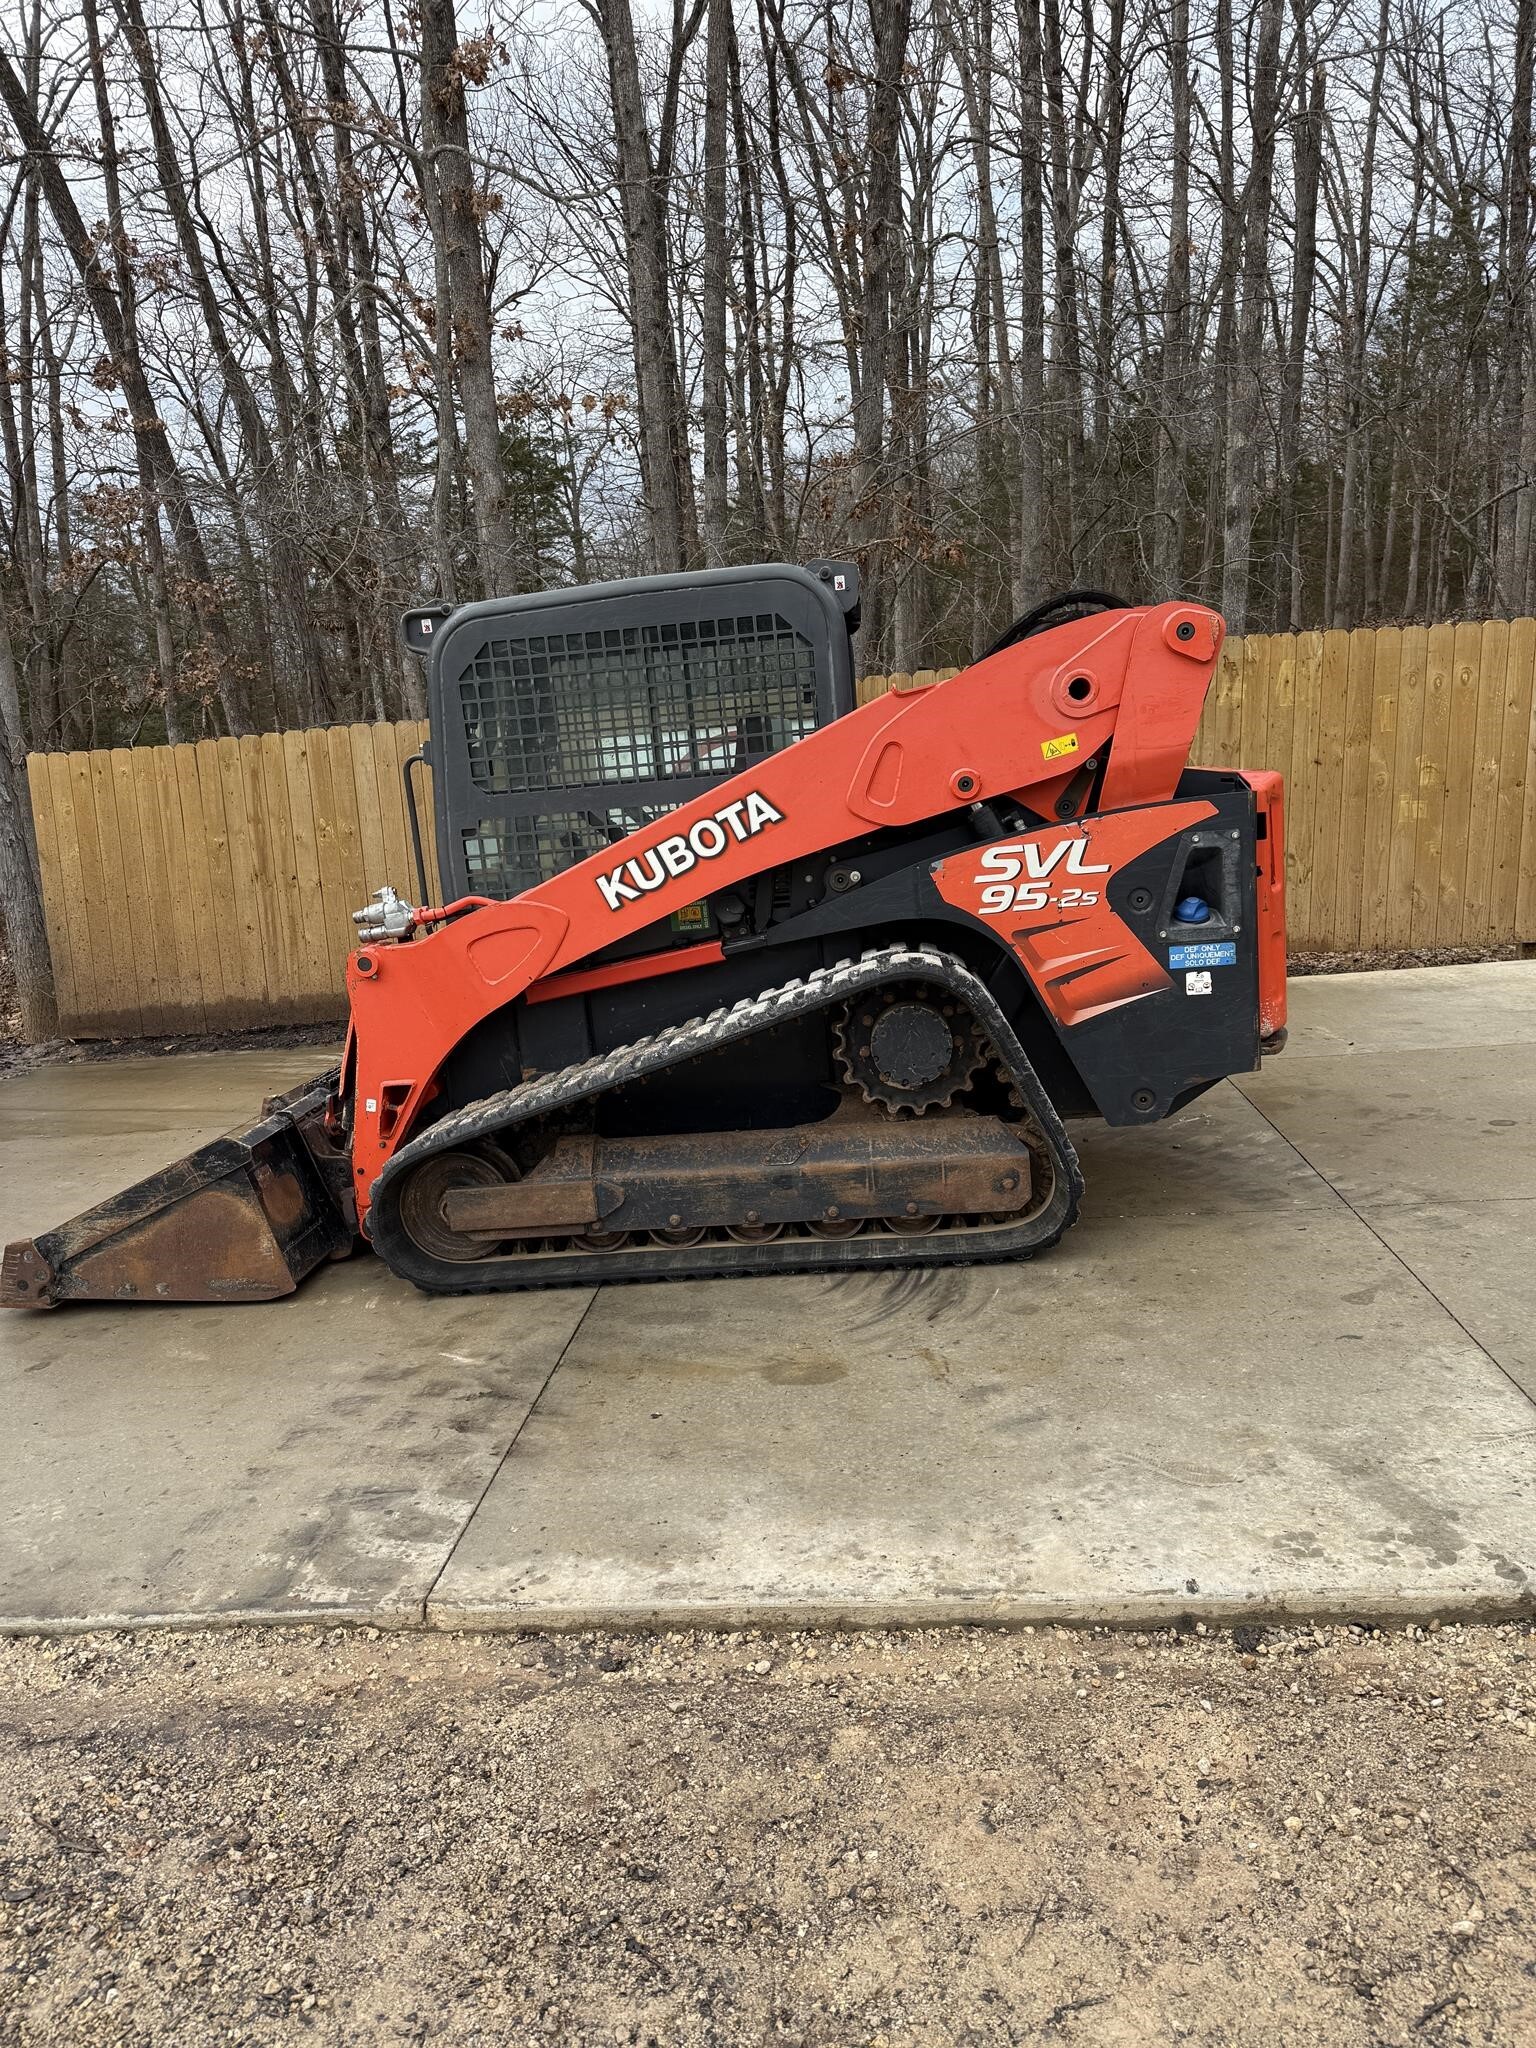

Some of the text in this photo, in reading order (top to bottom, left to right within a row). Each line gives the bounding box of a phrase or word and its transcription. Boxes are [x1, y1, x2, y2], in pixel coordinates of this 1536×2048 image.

[595, 791, 784, 911] KUBOTA
[974, 838, 1112, 884] SVL
[1184, 944, 1220, 953] DEF ONLY
[1186, 951, 1234, 959] UNIQUEMENT
